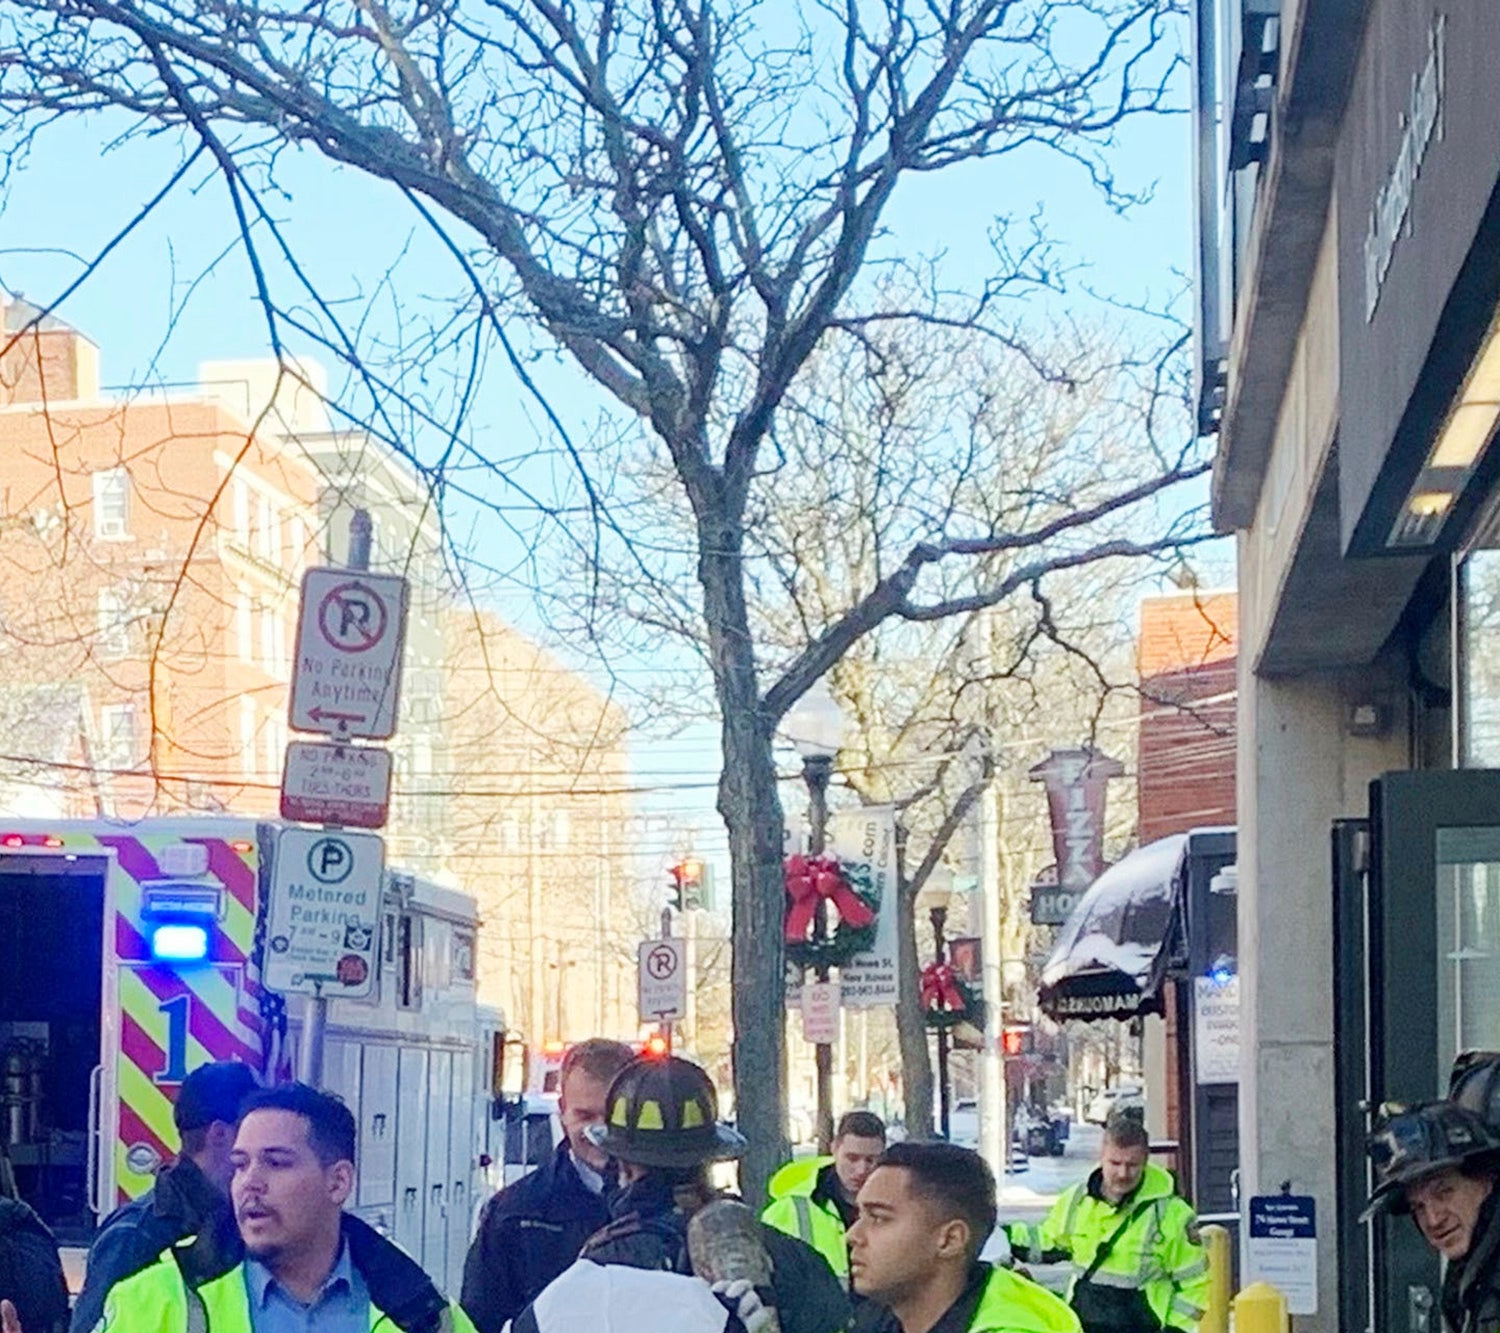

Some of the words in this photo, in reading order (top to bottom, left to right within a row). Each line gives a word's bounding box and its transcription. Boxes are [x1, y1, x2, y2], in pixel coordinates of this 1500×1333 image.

[289, 884, 367, 906] Metered
[291, 905, 360, 927] Parking
[155, 994, 190, 1084] 1
